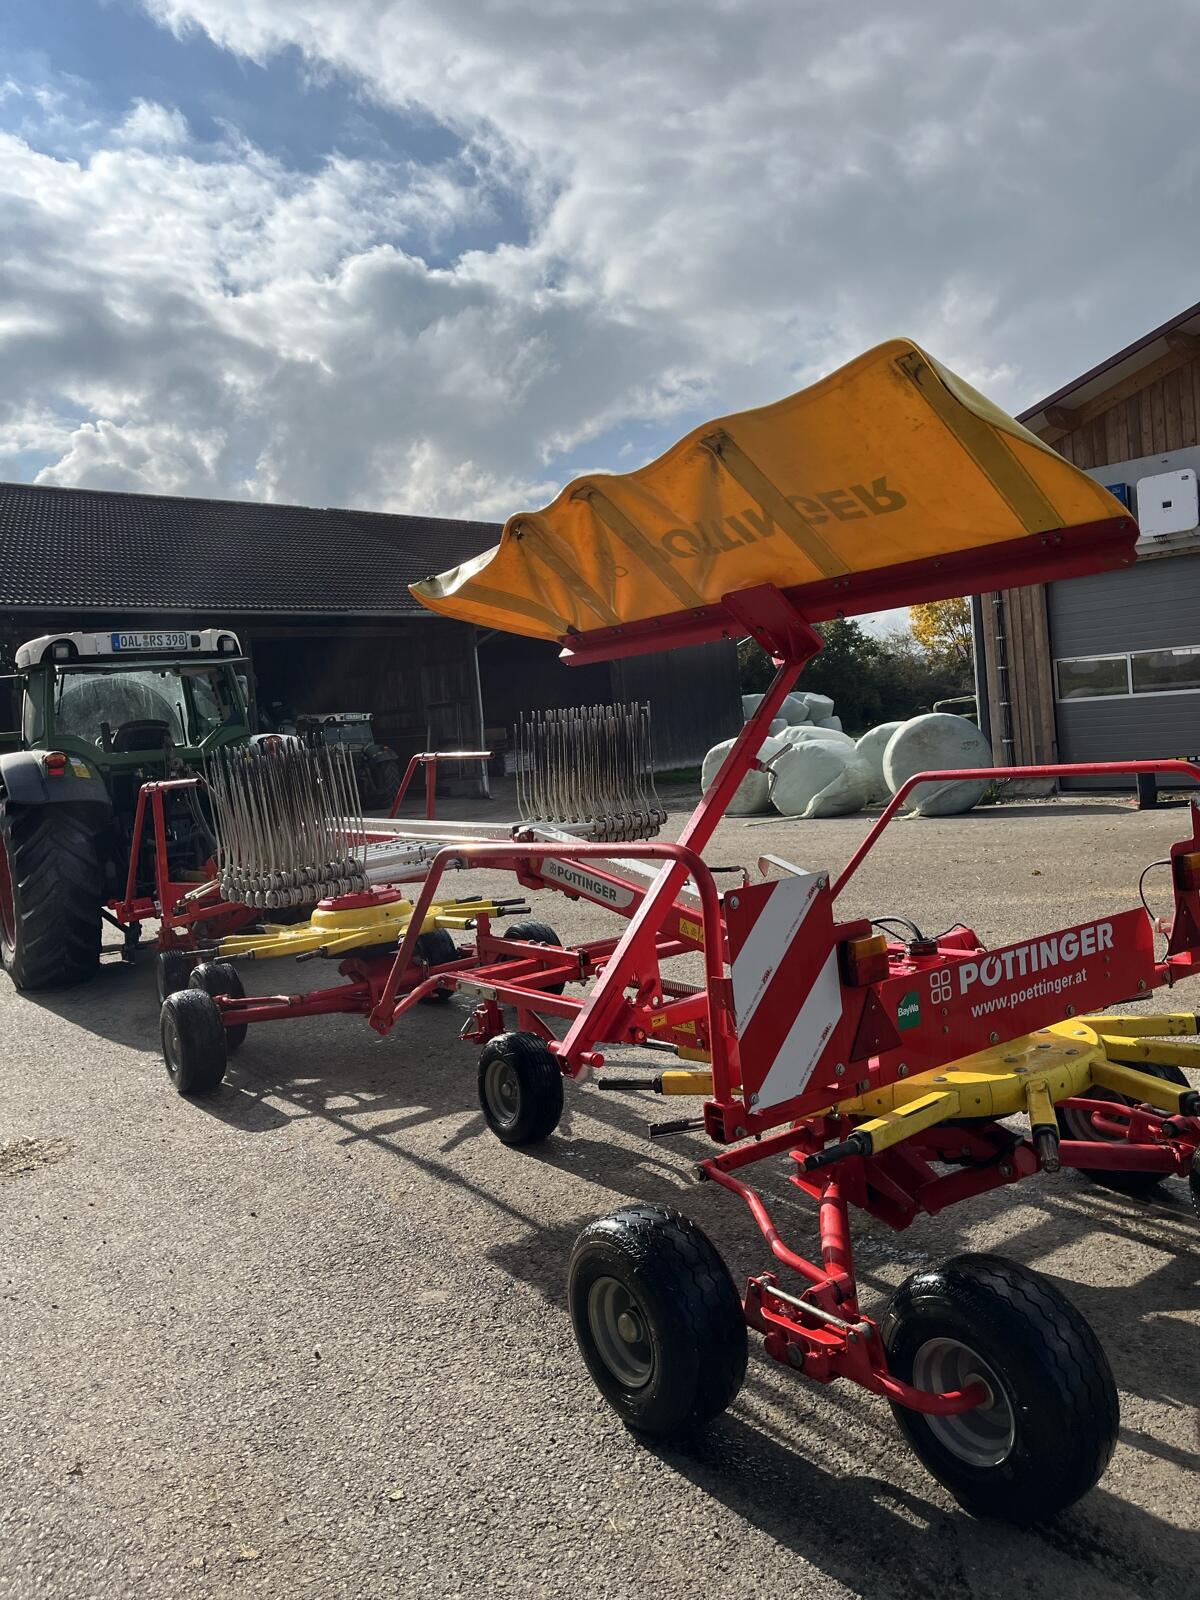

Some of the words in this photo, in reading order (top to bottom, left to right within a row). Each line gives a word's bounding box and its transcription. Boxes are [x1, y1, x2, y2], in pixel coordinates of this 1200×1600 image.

[121, 635, 142, 648] OAL
[149, 635, 163, 647] RS
[166, 634, 185, 646] 398
[958, 922, 1114, 995] PÖTTINGER
[971, 967, 1088, 1019] www.poettinger.at
[897, 1003, 919, 1017] BayWa
